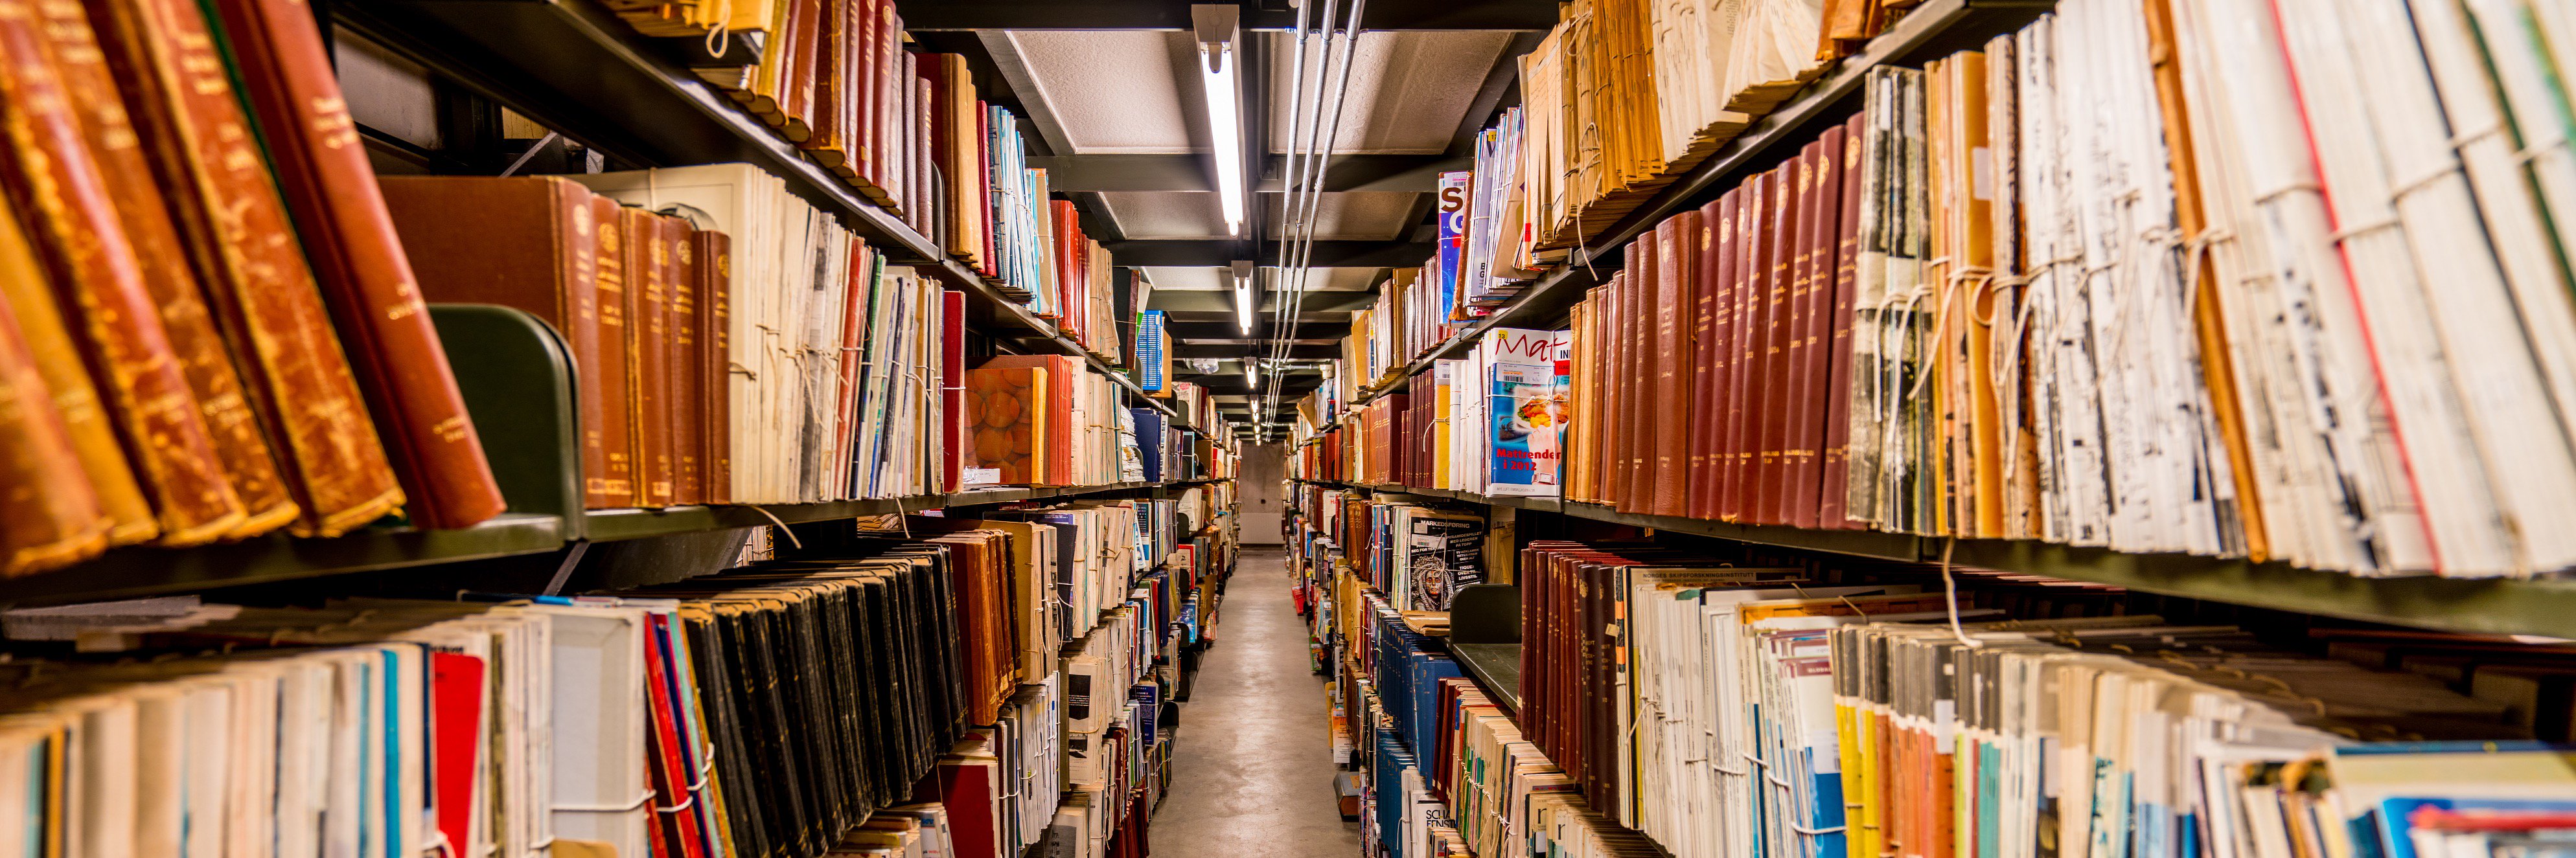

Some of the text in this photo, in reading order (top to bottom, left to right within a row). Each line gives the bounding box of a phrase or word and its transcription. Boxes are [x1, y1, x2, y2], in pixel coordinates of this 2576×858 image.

[1496, 448, 1561, 460] Mattrender
[1503, 459, 1537, 471] i 2012
[1421, 520, 1470, 528] MARKEDSFØRING
